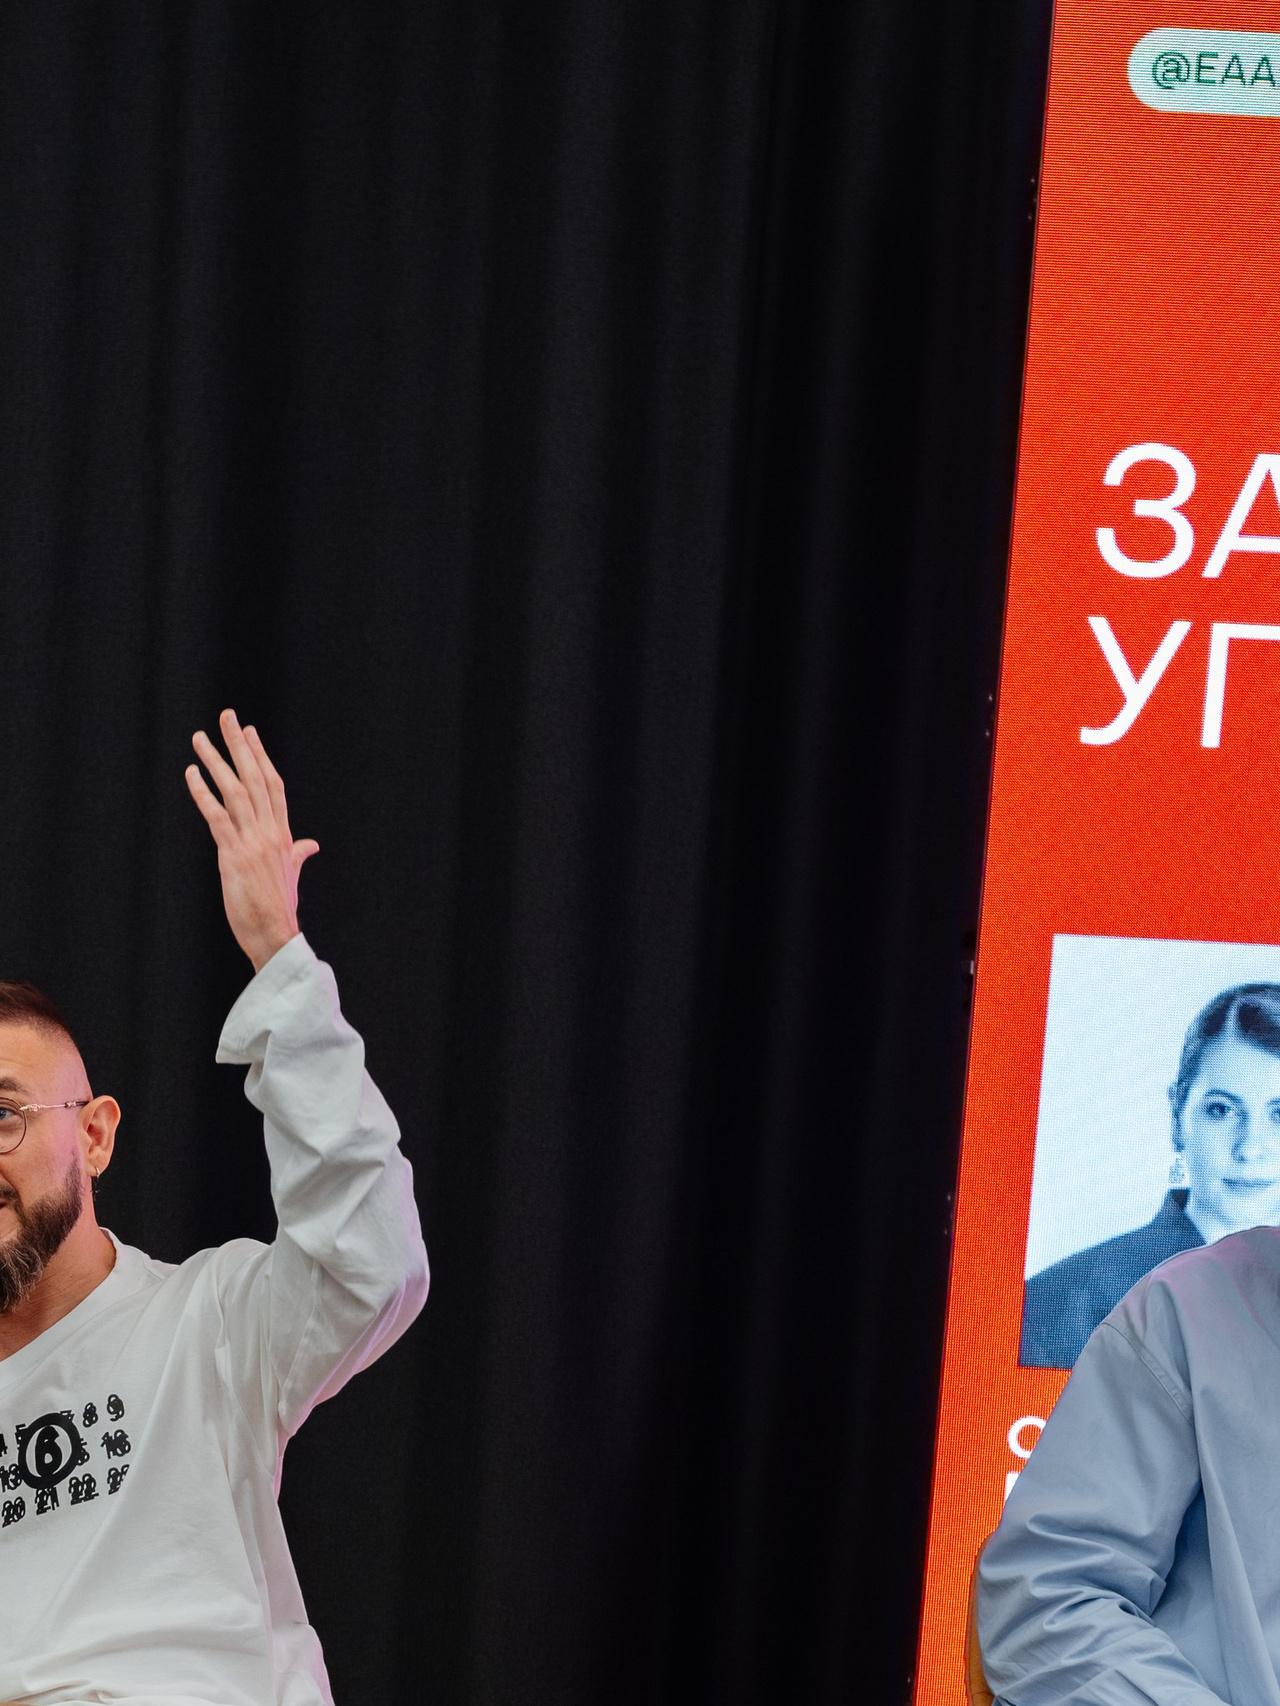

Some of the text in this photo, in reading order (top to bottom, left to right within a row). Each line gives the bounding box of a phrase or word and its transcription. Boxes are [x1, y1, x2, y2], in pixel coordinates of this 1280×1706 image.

[82, 1401, 99, 1428] 8
[106, 1393, 125, 1422] 9
[100, 1428, 132, 1459] 16
[1, 1496, 26, 1528] 20
[34, 1487, 60, 1516] 21
[68, 1472, 99, 1506] 22
